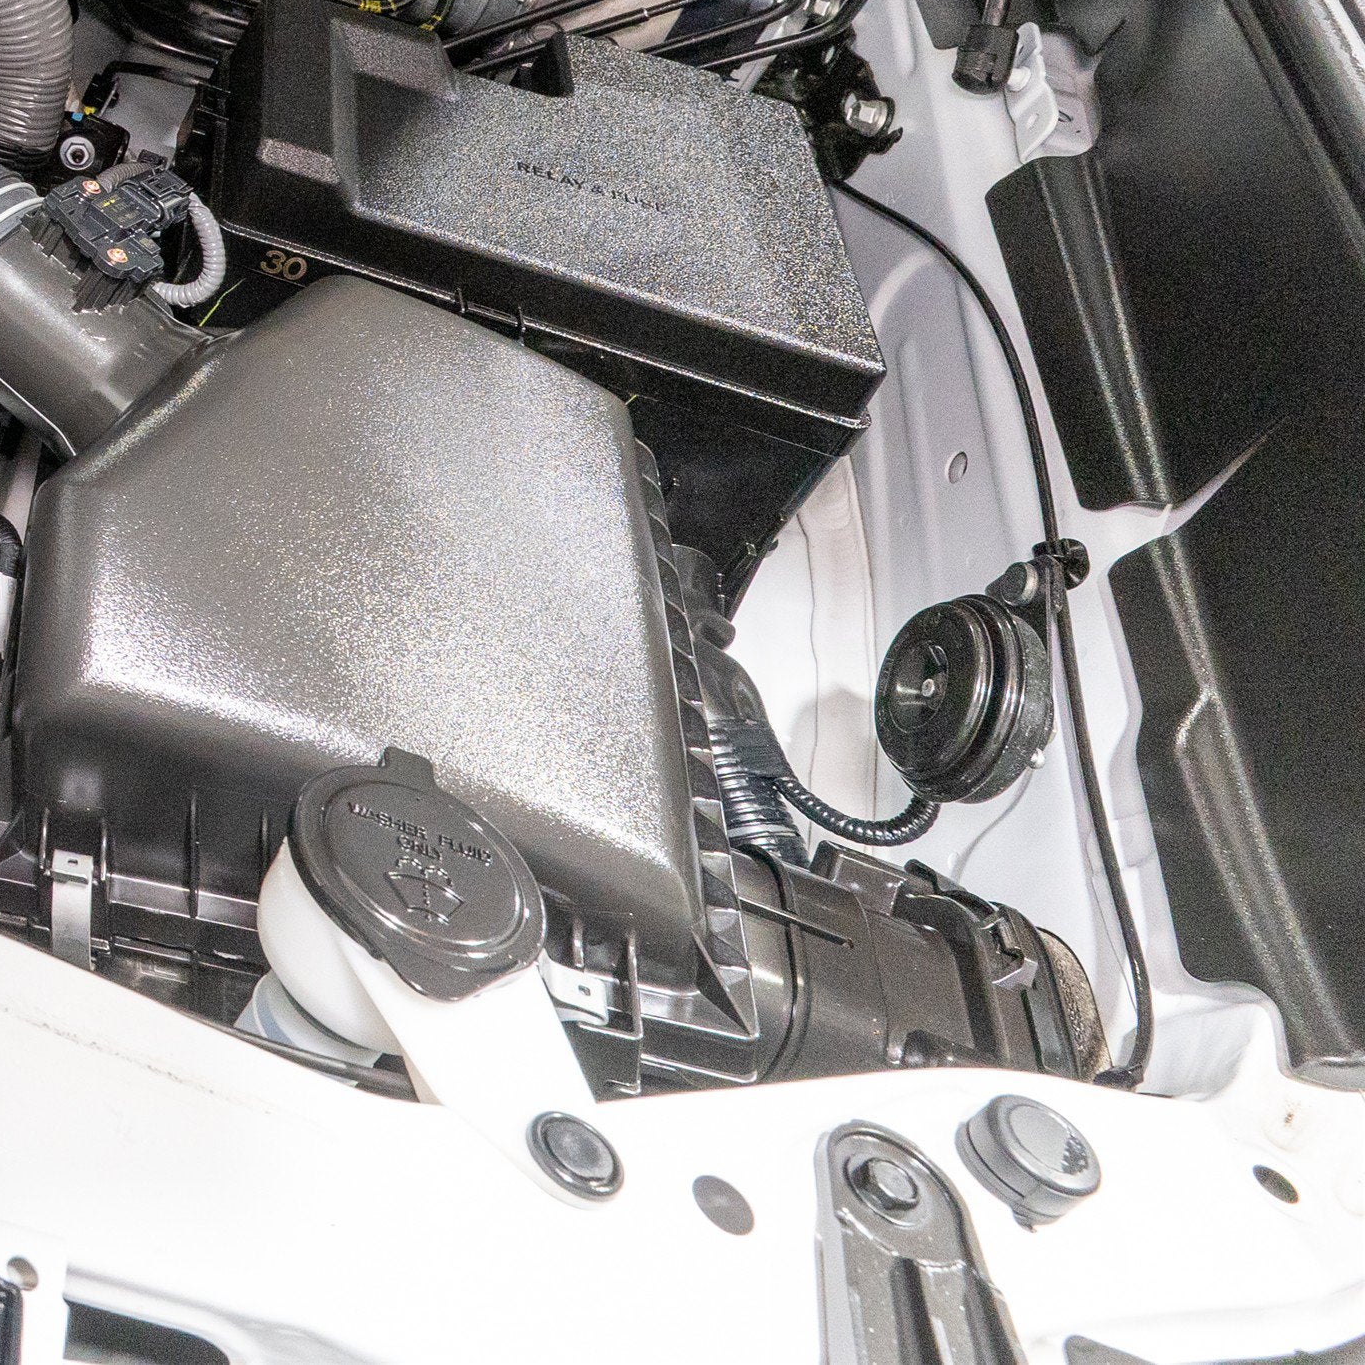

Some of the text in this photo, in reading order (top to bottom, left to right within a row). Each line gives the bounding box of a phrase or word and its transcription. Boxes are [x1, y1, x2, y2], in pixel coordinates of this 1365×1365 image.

[517, 161, 585, 189] RELAY
[260, 249, 307, 280] 30
[347, 802, 494, 867] WASHER FLUID
[397, 834, 443, 863] ONLY
